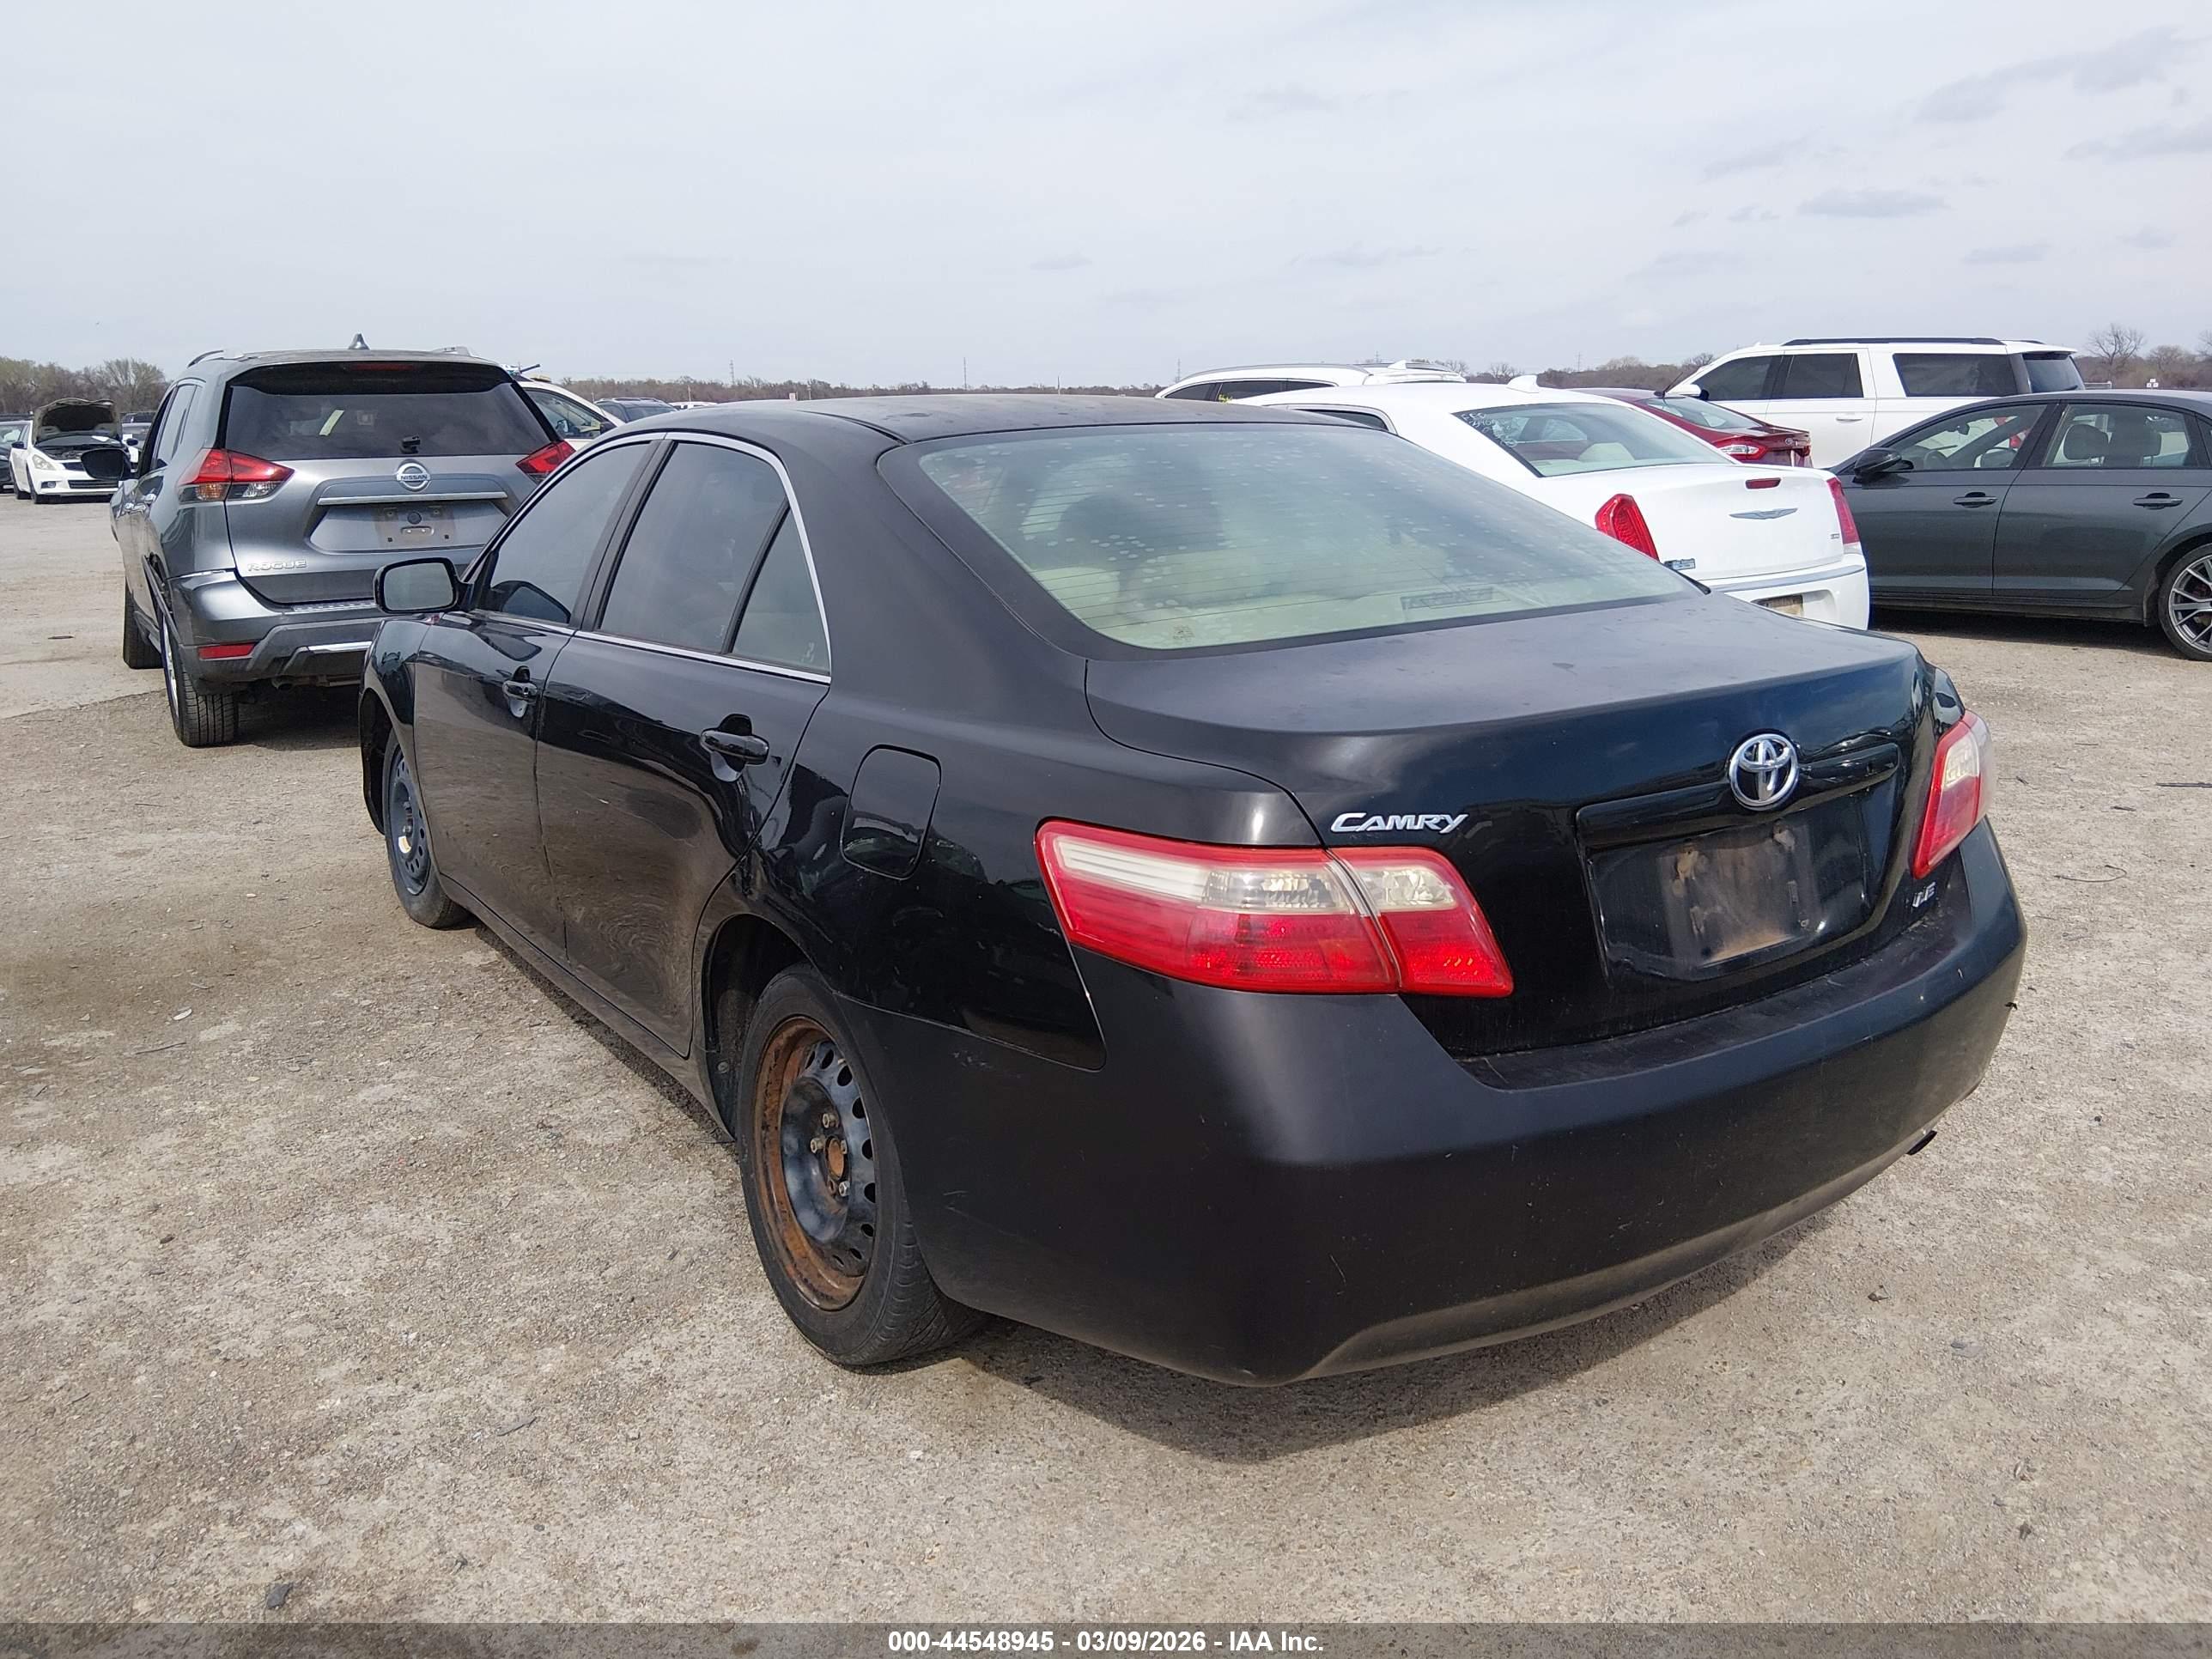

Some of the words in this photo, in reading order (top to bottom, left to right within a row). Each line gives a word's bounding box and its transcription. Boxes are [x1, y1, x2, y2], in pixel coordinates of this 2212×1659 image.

[247, 559, 307, 571] ROGUE
[1331, 812, 1469, 834] CAMRY
[1912, 881, 1936, 908] LE
